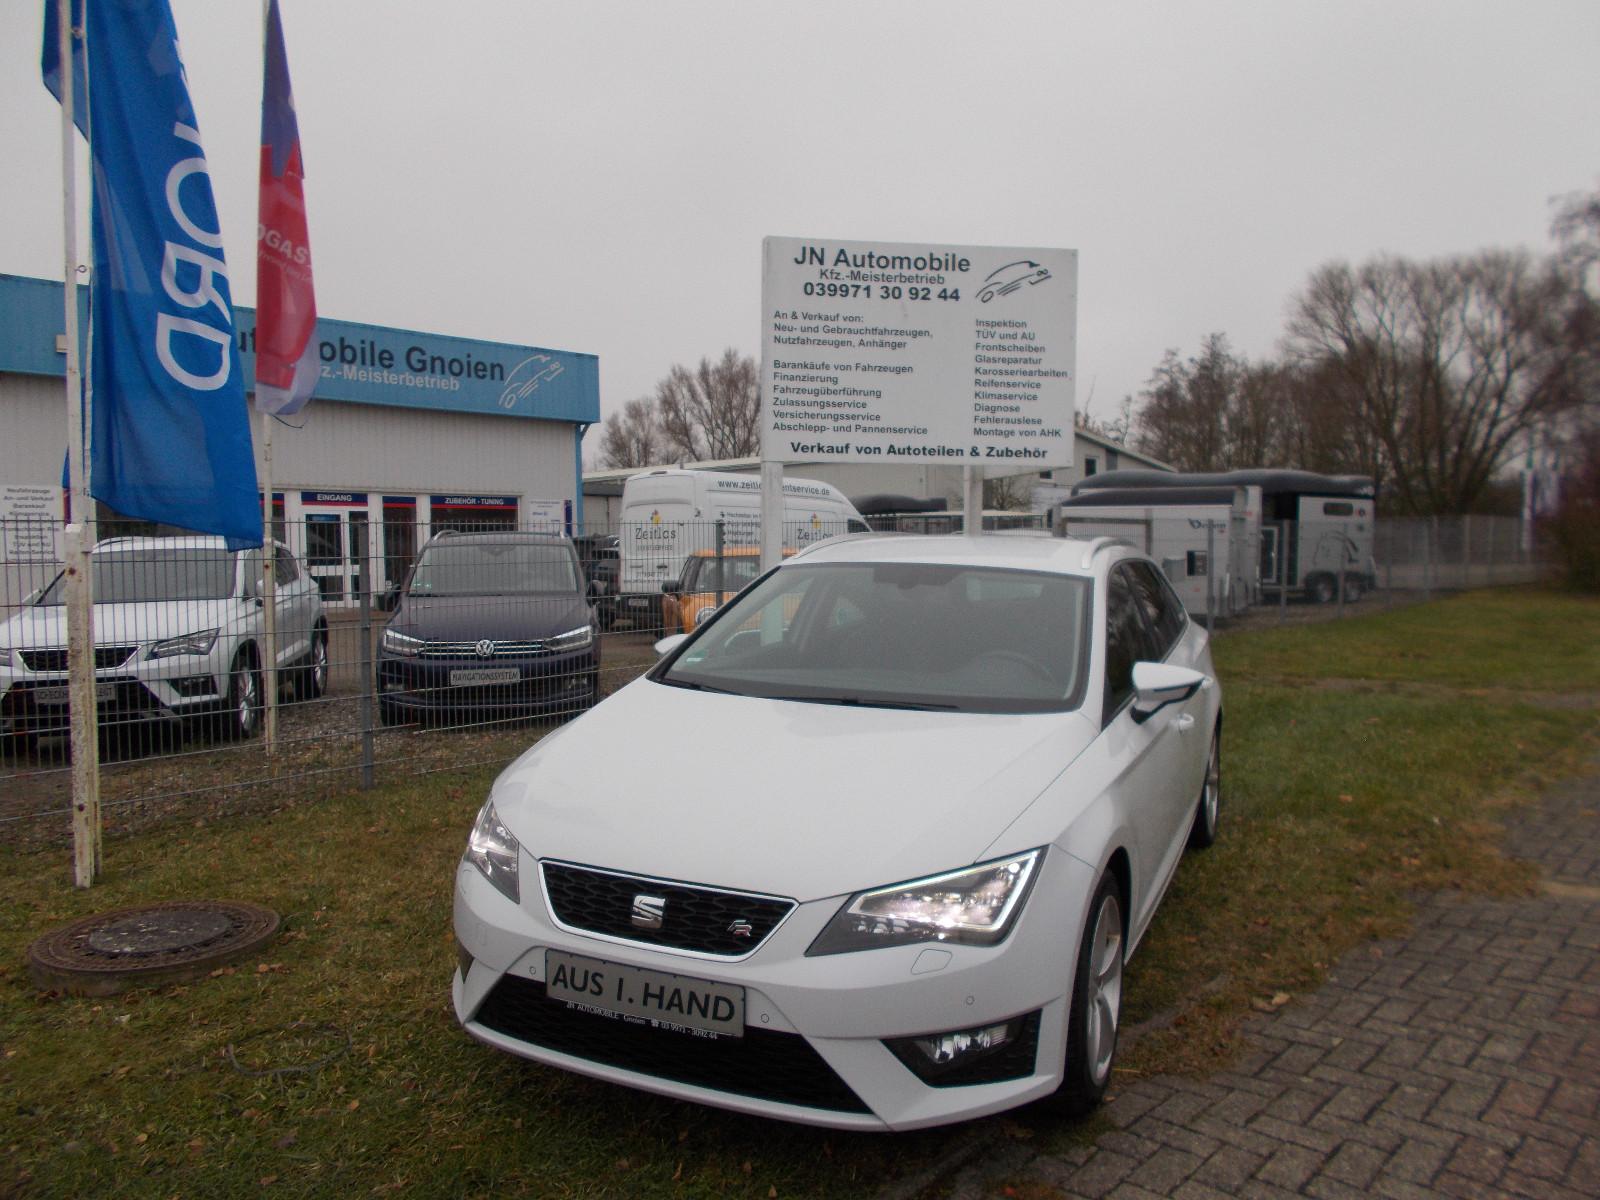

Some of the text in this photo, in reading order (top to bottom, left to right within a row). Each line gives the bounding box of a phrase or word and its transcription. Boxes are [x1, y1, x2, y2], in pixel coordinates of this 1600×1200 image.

[794, 246, 971, 272] JN Automobile
[819, 268, 945, 285] Kfz.-Meisterbetrieb
[803, 282, 961, 302] 039971 30 92 44
[773, 310, 864, 323] An & Verkauf von:
[773, 322, 797, 333] Neu-
[800, 323, 819, 333] und
[975, 319, 1028, 330] Inspektion
[975, 329, 1036, 341] TÜV und AU
[773, 335, 907, 350] Nutzfahrzeugen, Anhänger
[975, 342, 1046, 353] Frontscheiben
[405, 346, 505, 382] Gnoien
[975, 354, 1043, 365] Glasreparatur
[773, 360, 914, 375] Barankäufe von Fahrzeugen
[975, 367, 1068, 378] Karosseriearbeiten
[321, 365, 460, 392] z.-Meisterbetrieb
[773, 372, 839, 385] Finanzierung
[974, 379, 1042, 389] Reifenservice
[773, 385, 882, 398] Fahrzeugüberführung
[974, 391, 1039, 401] Klimaservice
[772, 397, 868, 409] Zulassungsservice
[974, 403, 1021, 413] Diagnose
[772, 410, 881, 422] Versicherungsservice
[974, 415, 1043, 425] Fehlerauslese
[772, 422, 928, 436] Abschlepp- und Pannenservice
[973, 427, 1062, 439] Montage von AHK
[790, 441, 1048, 459] Verkauf von Autoteilen & Zubehör
[316, 493, 353, 502] EINGANG
[444, 497, 505, 506] ZUBEHÖR TUNING
[552, 963, 605, 997] AUS
[642, 982, 736, 1022] HAND
